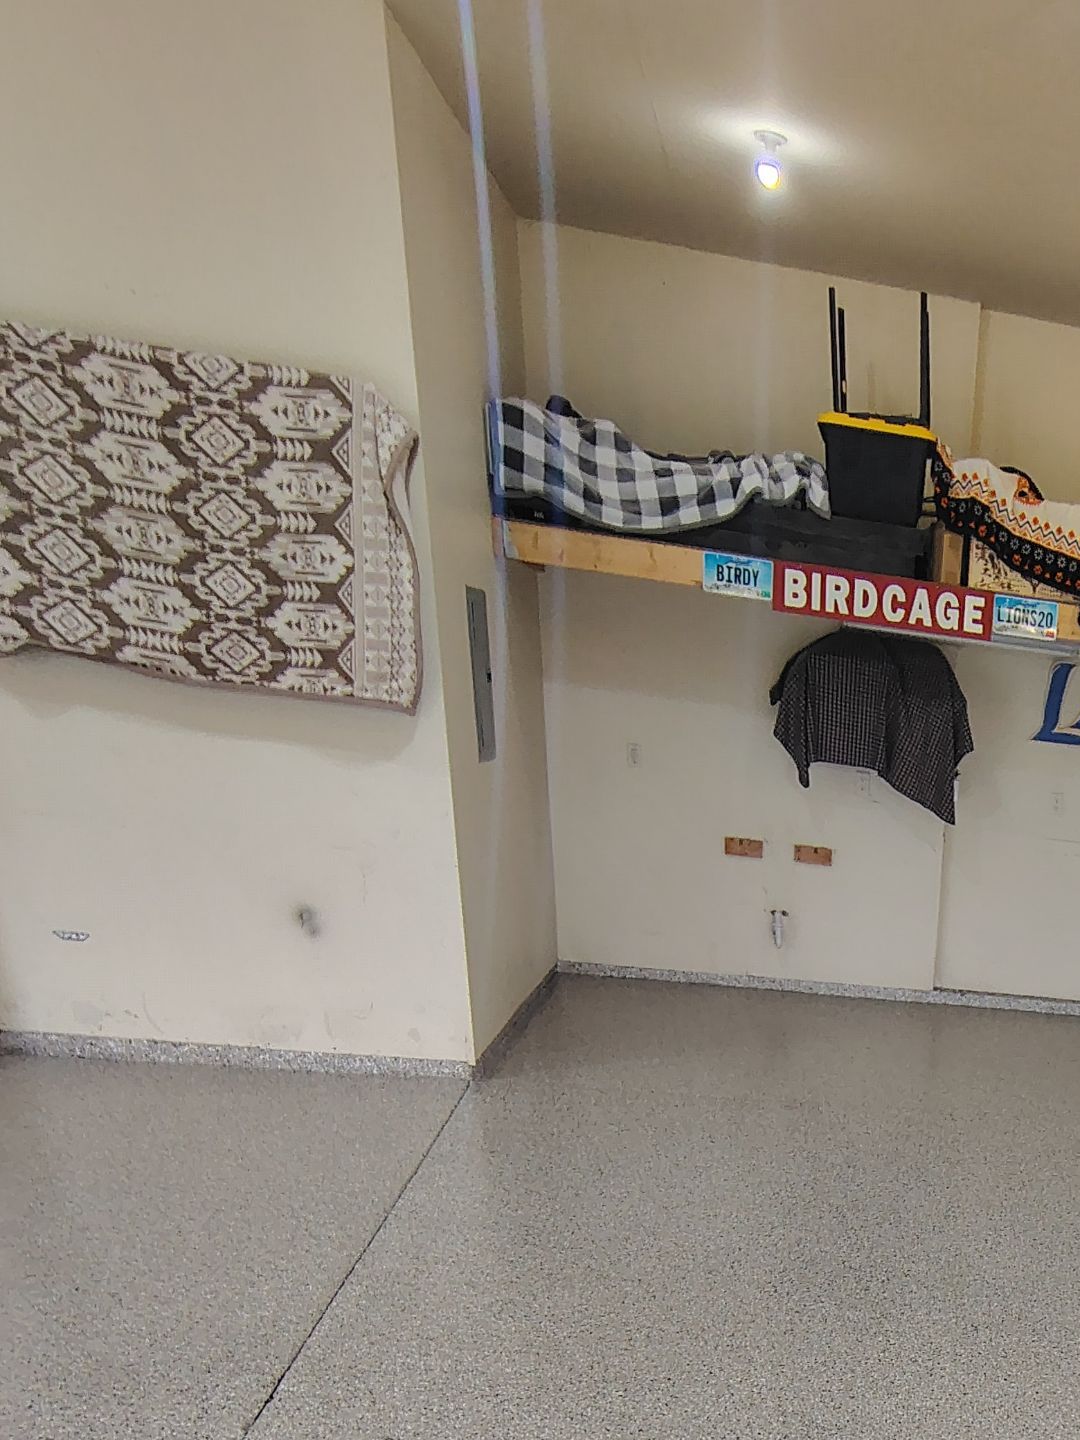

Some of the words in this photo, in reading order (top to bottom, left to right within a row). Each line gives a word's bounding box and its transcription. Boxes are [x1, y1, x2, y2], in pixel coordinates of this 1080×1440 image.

[716, 563, 760, 588] BIRDY
[783, 567, 986, 635] BIRDCAGE
[997, 604, 1054, 629] LIONS20
